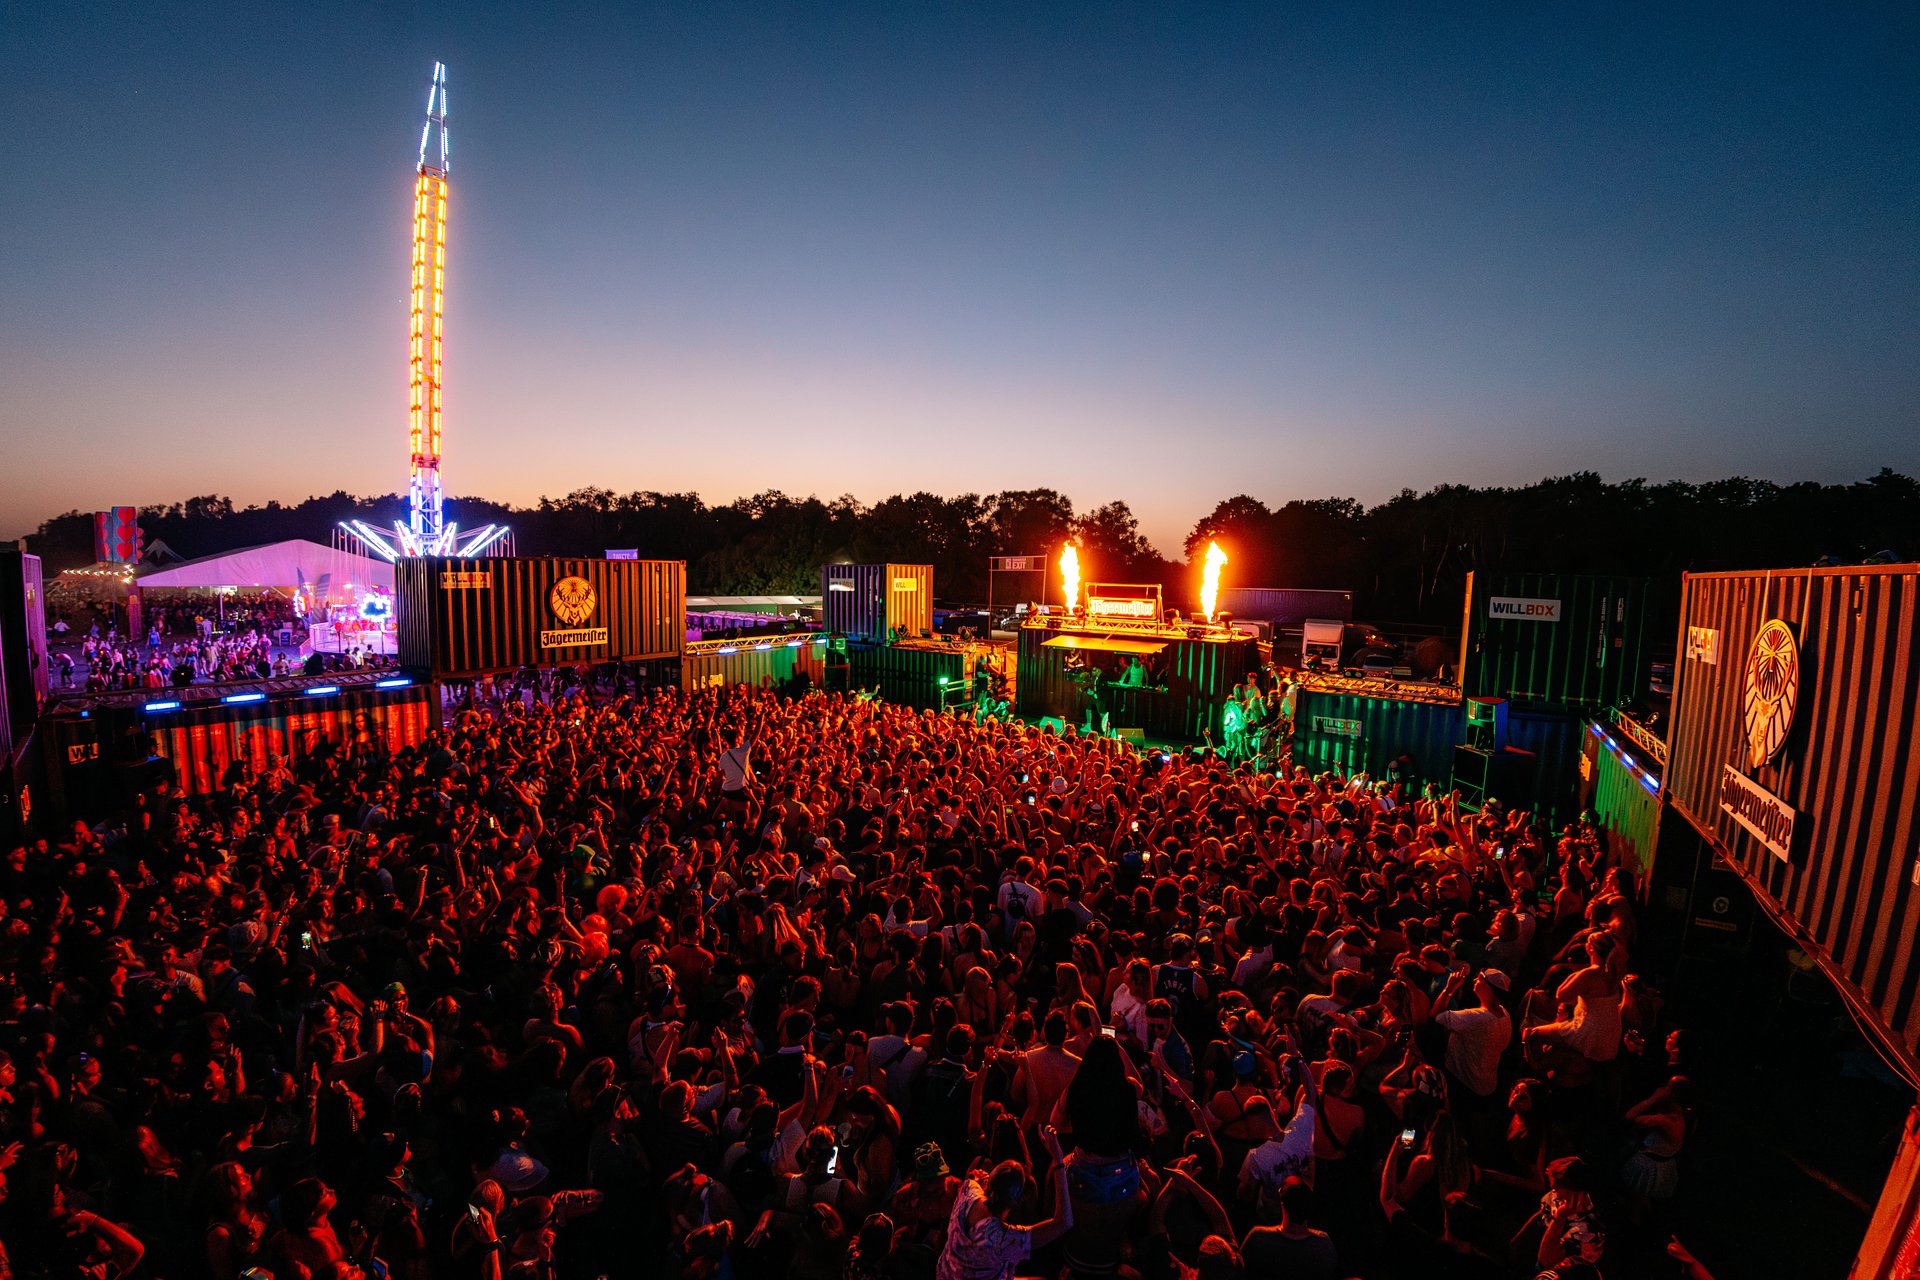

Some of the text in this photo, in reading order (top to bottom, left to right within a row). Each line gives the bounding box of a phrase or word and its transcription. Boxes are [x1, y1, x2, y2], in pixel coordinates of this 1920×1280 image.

[1012, 561, 1027, 569] EXIT
[1492, 602, 1555, 617] WILLBOX
[542, 630, 607, 646] Jägermeister
[1721, 768, 1792, 851] Jägermeister
